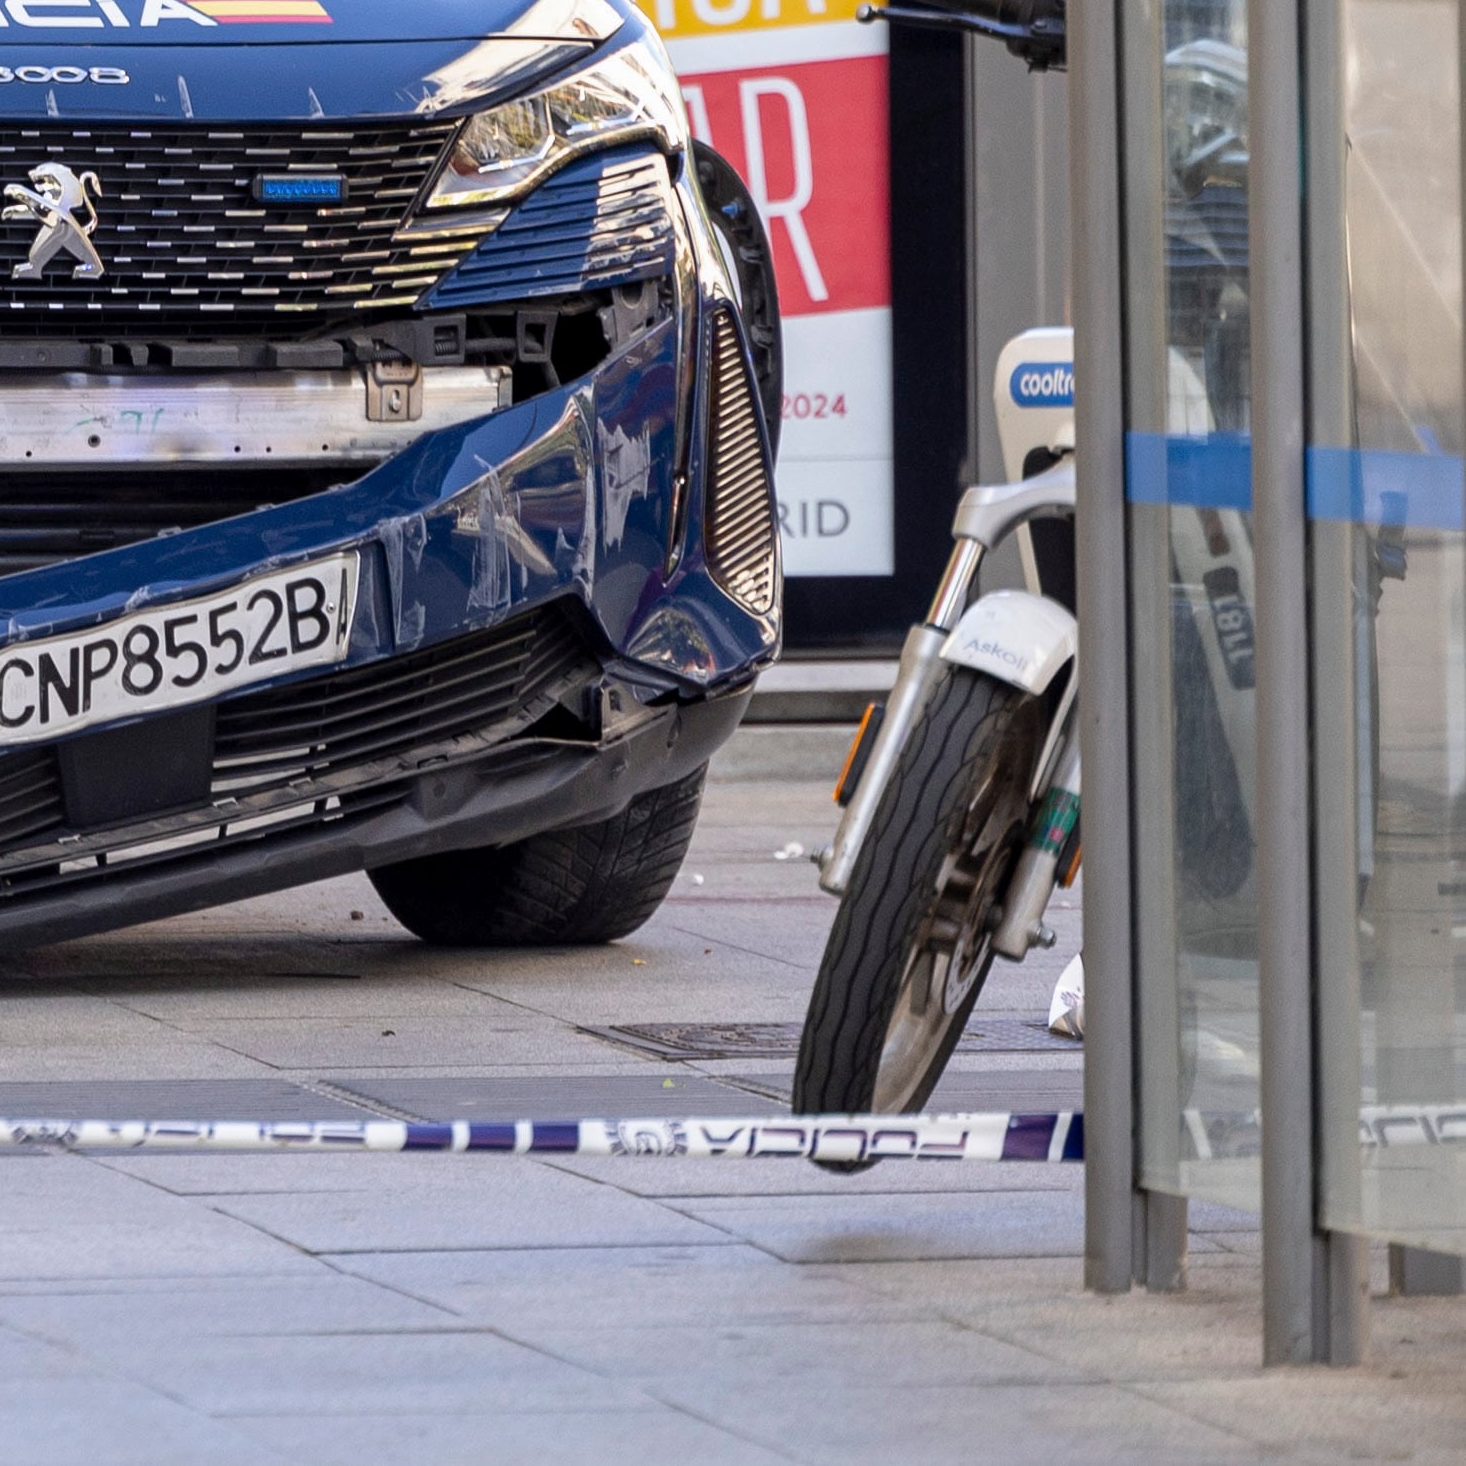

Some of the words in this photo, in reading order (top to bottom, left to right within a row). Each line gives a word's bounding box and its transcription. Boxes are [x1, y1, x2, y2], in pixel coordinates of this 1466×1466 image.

[777, 500, 851, 539] RID
[963, 638, 1029, 672] Askoll
[700, 1126, 969, 1161] POLICIA
